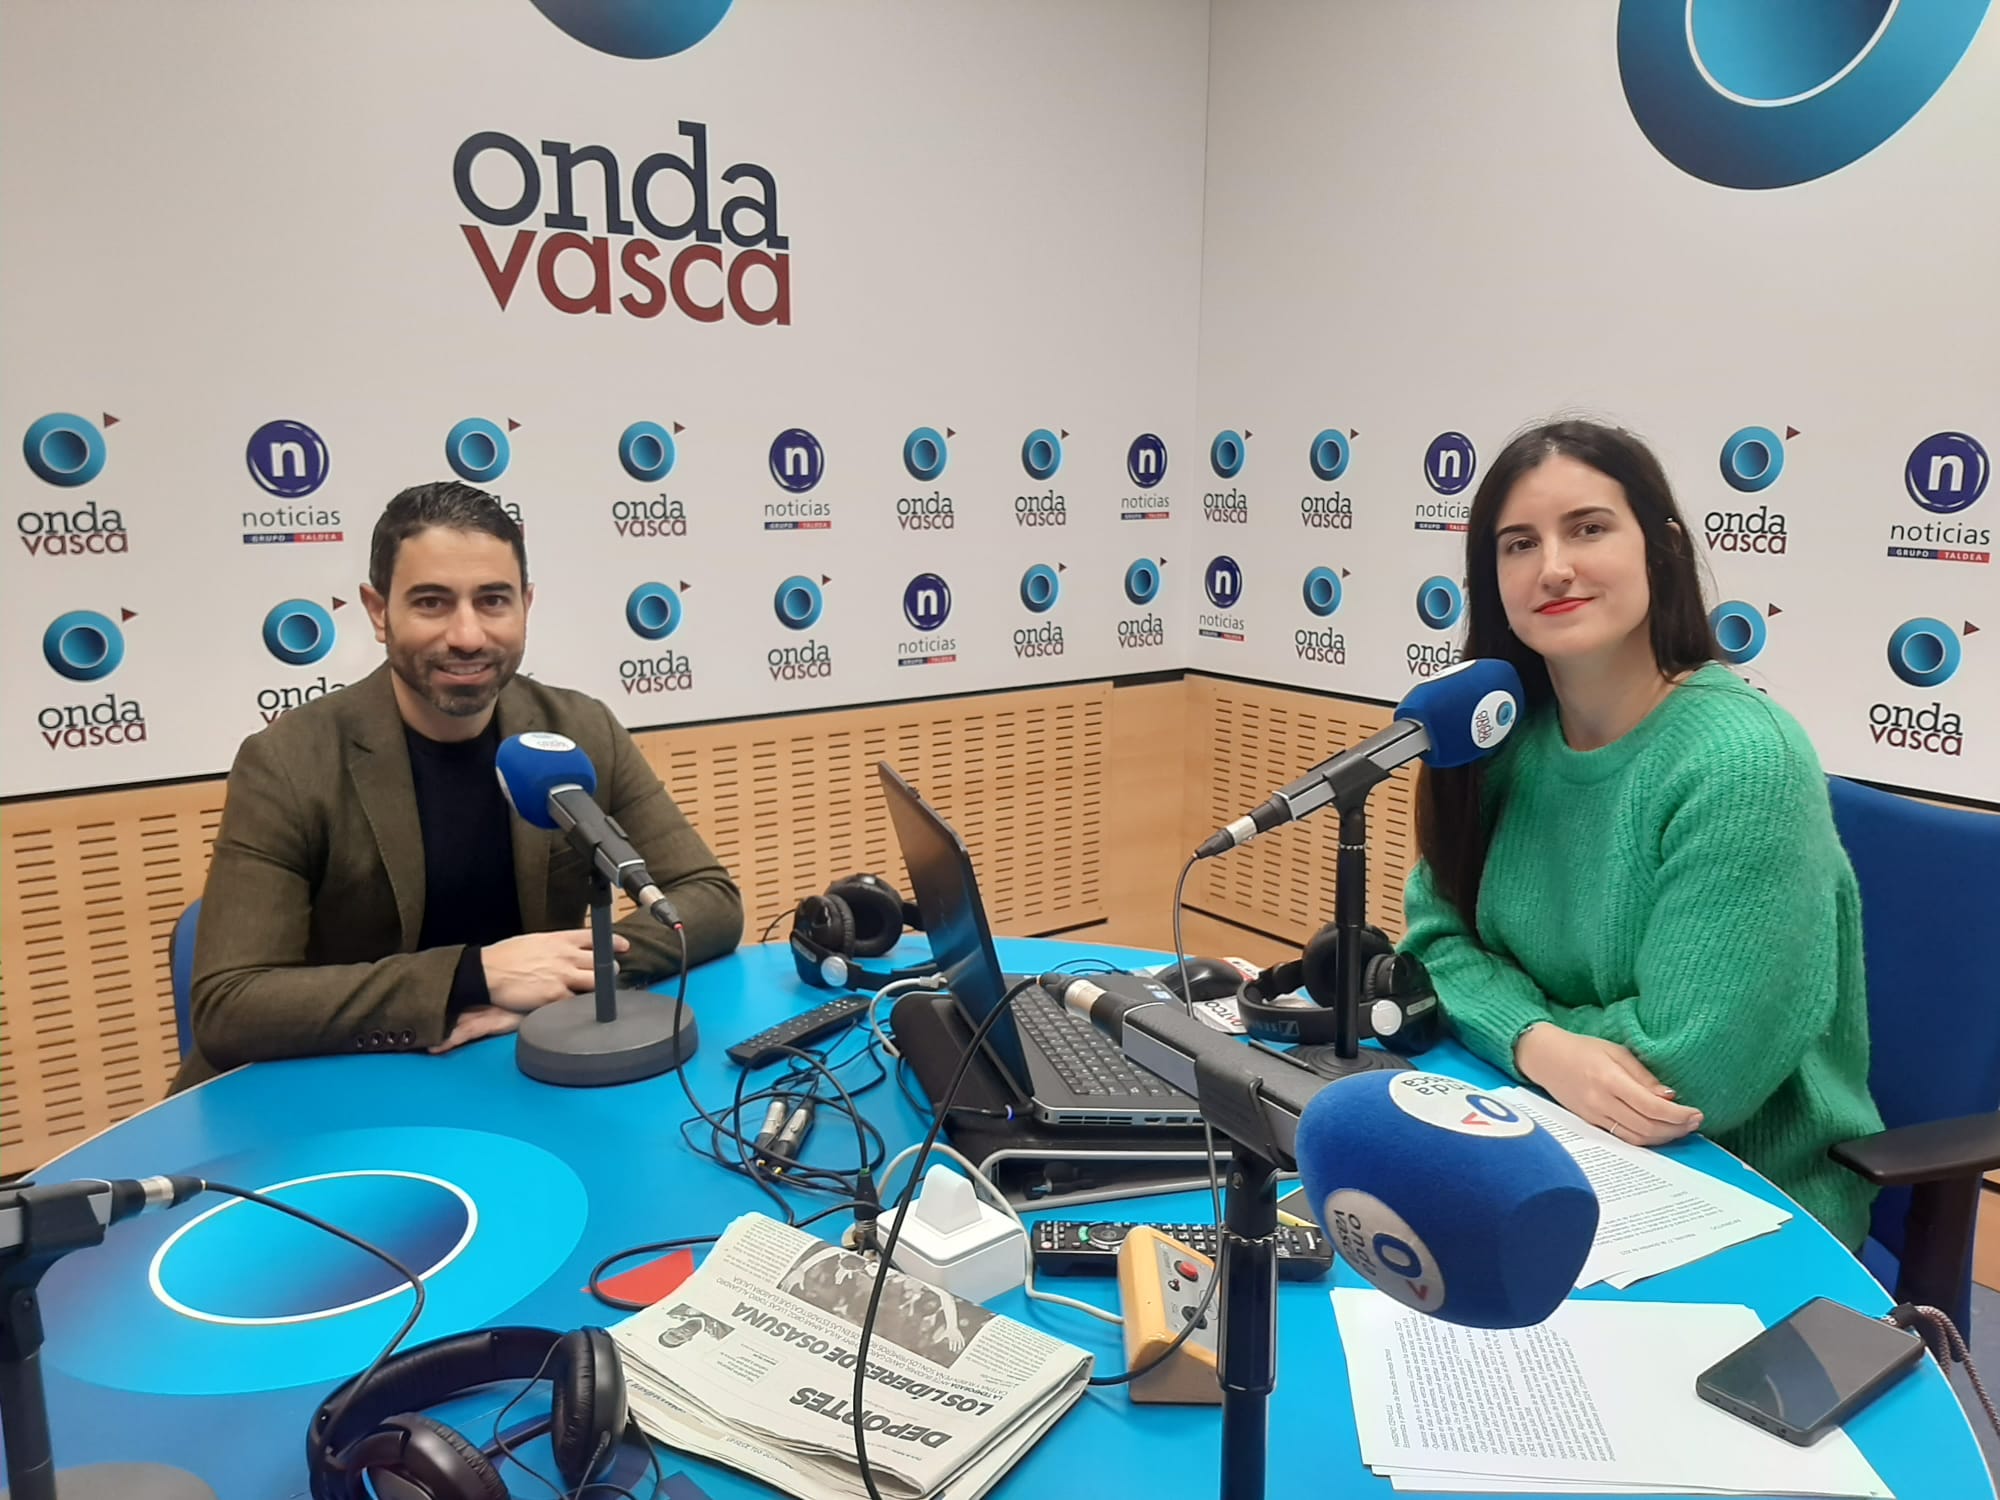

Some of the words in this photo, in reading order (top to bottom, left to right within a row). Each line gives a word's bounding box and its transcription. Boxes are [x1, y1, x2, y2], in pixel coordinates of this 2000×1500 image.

[453, 120, 789, 250] onda
[459, 224, 791, 326] vasca
[612, 494, 686, 521] onda
[764, 499, 831, 517] noticias
[896, 491, 954, 516] onda
[1015, 489, 1066, 513] onda
[1121, 493, 1169, 509] noticias
[1203, 488, 1247, 510] onda
[1301, 491, 1352, 514] onda
[1416, 501, 1470, 518] noticia
[17, 501, 126, 535] onda
[242, 505, 341, 527] noticias
[898, 514, 955, 531] vasca
[1016, 511, 1066, 527] vasca
[1203, 507, 1248, 524] vasca
[1301, 512, 1352, 530] vasca
[1704, 505, 1788, 536] onda
[614, 519, 687, 538] vasca
[1890, 522, 1991, 546] noticias
[20, 531, 129, 557] vasca
[1705, 532, 1788, 554] vasca
[1896, 549, 1930, 559] GRUPO
[1945, 551, 1983, 561] TALDEA
[1117, 613, 1163, 636] onda
[1199, 613, 1245, 630] noticias
[1013, 621, 1063, 646] onda
[1118, 630, 1163, 649] vasca
[1295, 627, 1346, 650] onda
[768, 640, 831, 667] onda
[898, 637, 956, 655] noticias
[1014, 640, 1064, 659] vasca
[1296, 644, 1346, 665] vasca
[619, 650, 692, 679] onda
[769, 660, 831, 682] vasca
[257, 677, 346, 710] ond
[621, 673, 693, 695] vasca
[38, 693, 144, 729] onda
[1869, 703, 1963, 736] onda
[41, 722, 147, 750] vasca
[1869, 724, 1963, 757] vasca
[731, 1302, 829, 1354] OSASUNA
[825, 1347, 858, 1369] DE
[941, 1394, 994, 1417] LOS
